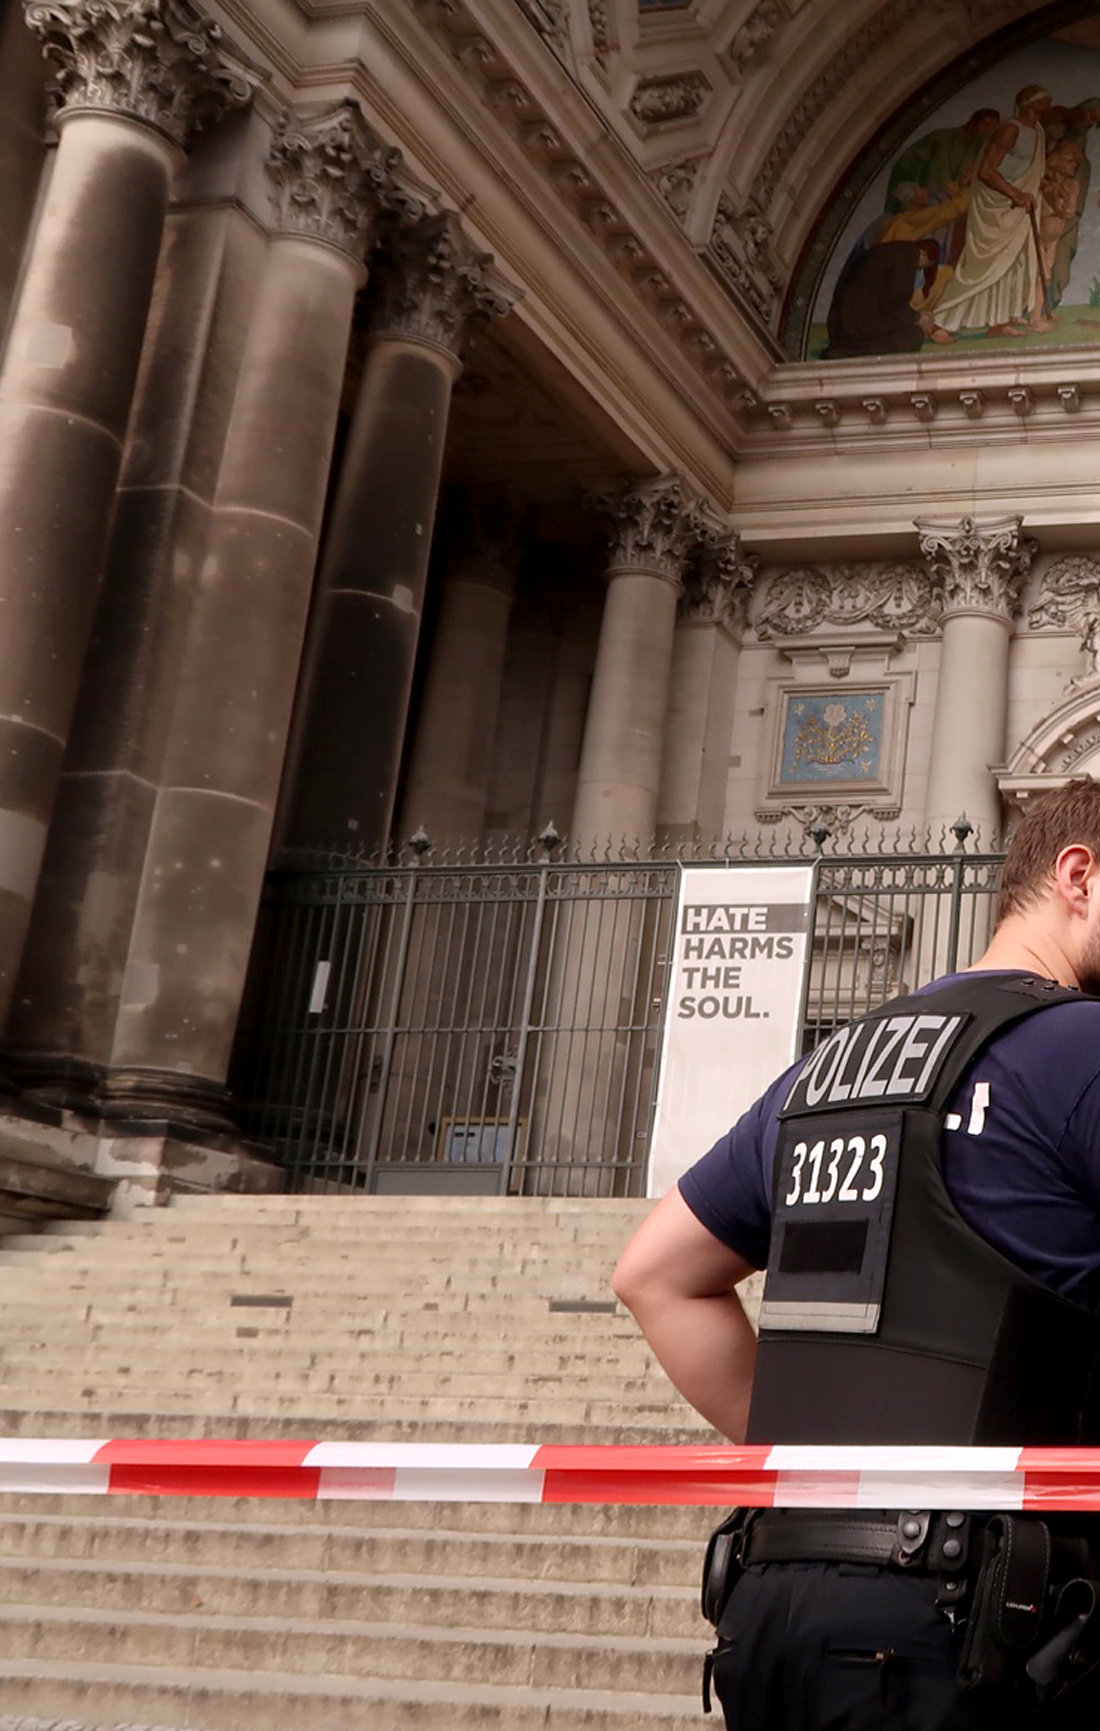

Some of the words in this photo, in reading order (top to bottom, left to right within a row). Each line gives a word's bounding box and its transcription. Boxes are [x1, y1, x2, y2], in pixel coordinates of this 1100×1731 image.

[686, 907, 768, 932] HATE
[683, 936, 793, 960] HARMS
[682, 966, 742, 989] THE
[677, 996, 770, 1019] SOUL.
[783, 1015, 961, 1111] POLIZEI
[785, 1134, 887, 1206] 31323
